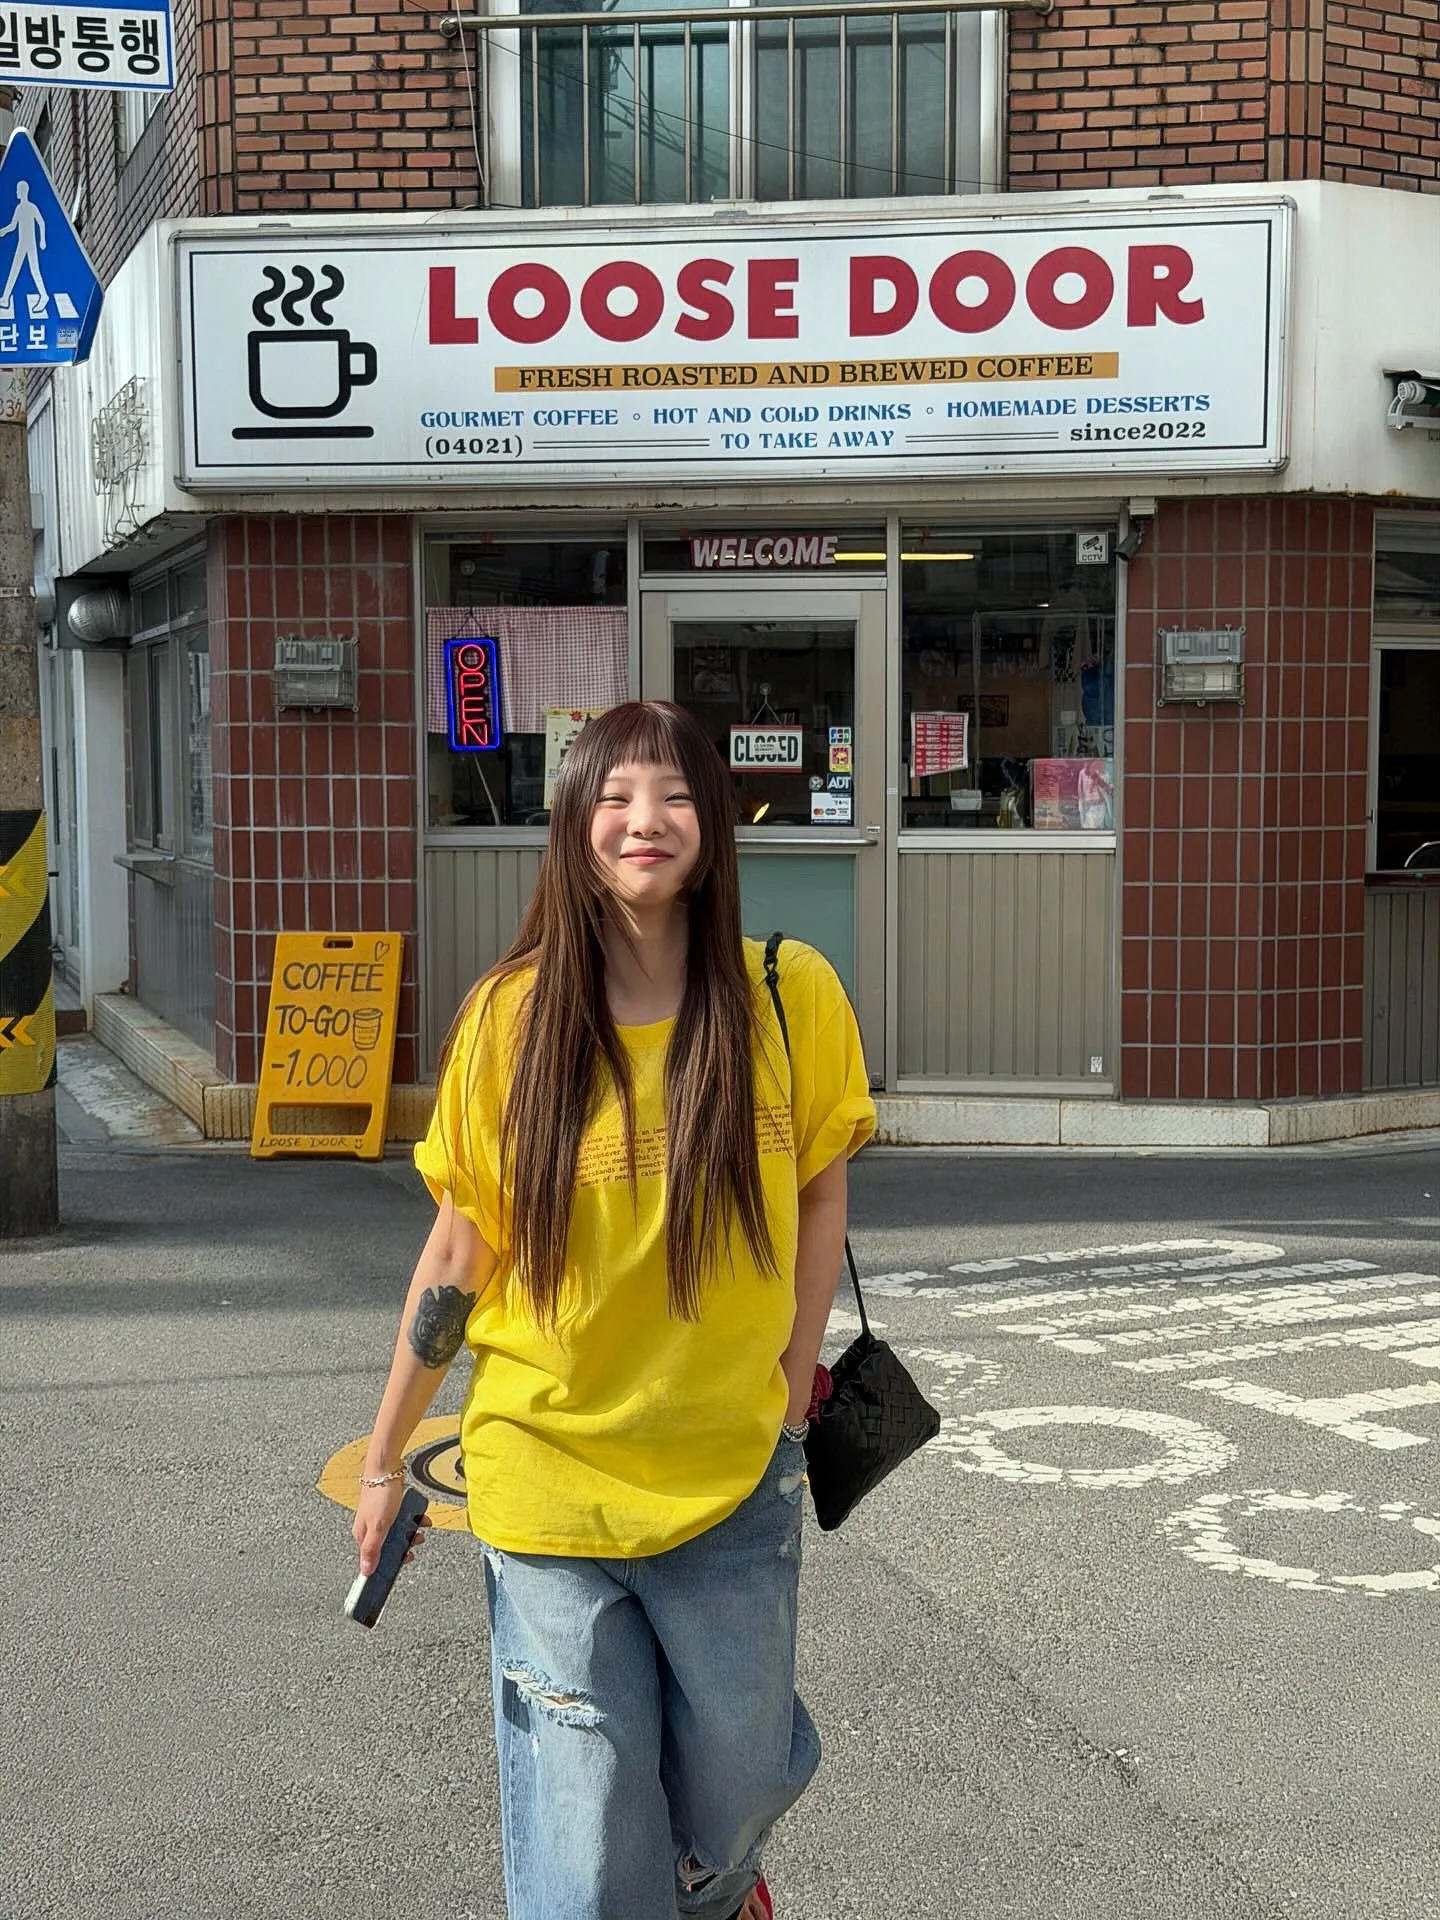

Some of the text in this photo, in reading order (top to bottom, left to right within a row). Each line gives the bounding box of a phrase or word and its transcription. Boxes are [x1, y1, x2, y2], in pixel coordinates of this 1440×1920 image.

[429, 245, 1205, 344] LOOSE DOOR
[519, 355, 1093, 389] FRESH ROASTED AND BREWED COFFEE
[420, 394, 1210, 428] GOURMET COFFEE HOT AND COLD DRINKS HOMEMADE DESSERTS
[425, 435, 523, 458] (04021)
[721, 430, 895, 449] TO TAKE AWAY
[1070, 421, 1206, 442] since2022
[693, 536, 838, 568] WELCOME
[457, 644, 488, 746] OPEN
[828, 776, 851, 789] ADT
[282, 962, 385, 992] COFFEE
[275, 1004, 350, 1038] TO-GO
[259, 1136, 348, 1148] LOOSE DOOR
